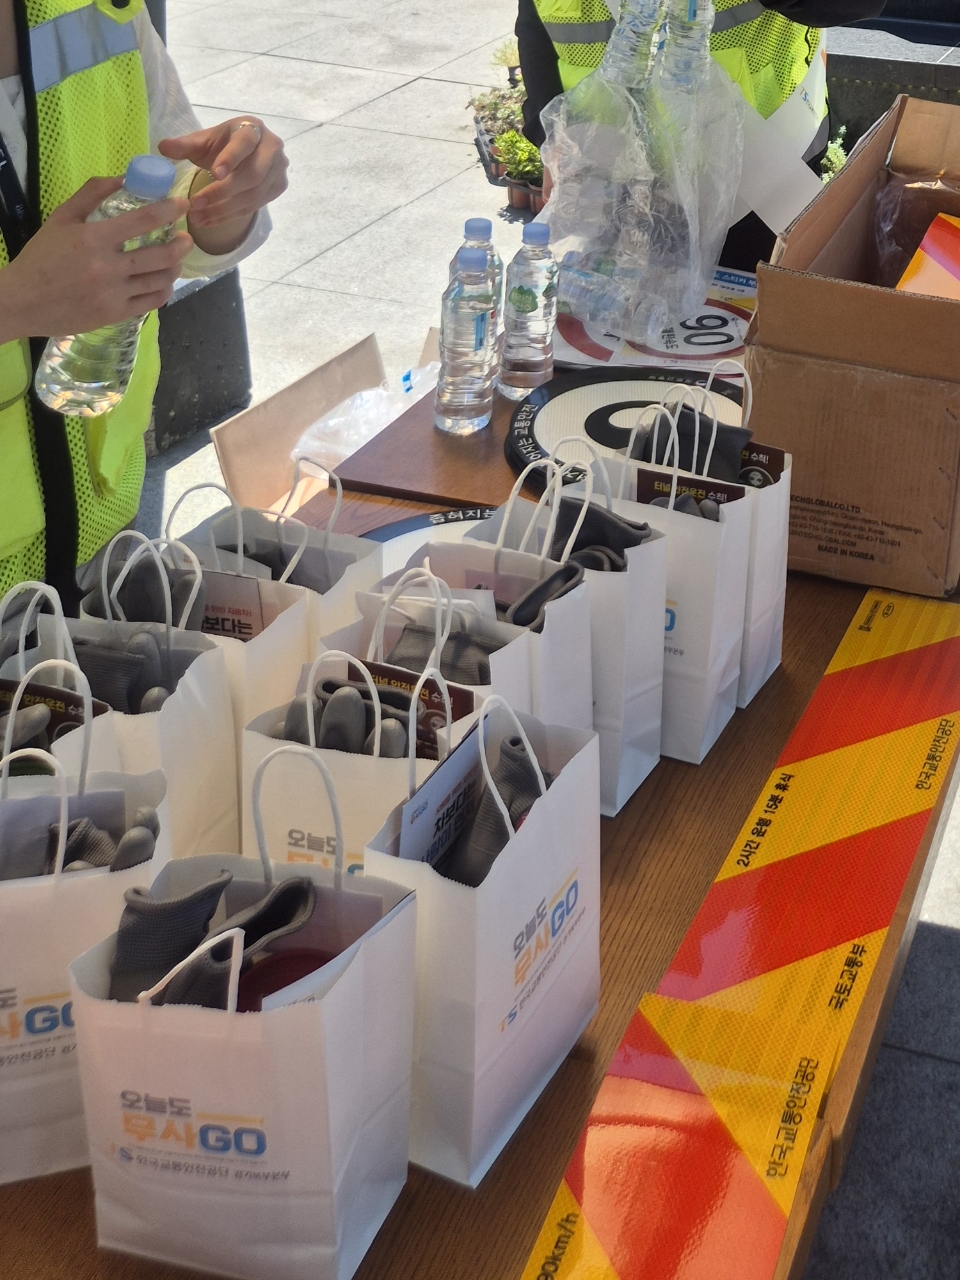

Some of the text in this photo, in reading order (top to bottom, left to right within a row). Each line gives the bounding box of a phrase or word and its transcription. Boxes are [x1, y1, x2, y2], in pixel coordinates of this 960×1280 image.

[679, 314, 735, 346] 90
[513, 404, 540, 436] 교통안전
[817, 544, 838, 555] MADE
[849, 550, 875, 561] KOREA
[201, 615, 254, 636] 보다는
[915, 717, 956, 791] 한국교통안전공단
[736, 839, 761, 867] 2시간
[763, 793, 784, 815] 15분
[774, 772, 795, 792] 휴식
[513, 897, 548, 960] 오늘도
[828, 942, 867, 1011] 국토교통부
[120, 1089, 192, 1118] 오늘도
[765, 1055, 820, 1178] 한국교통안전공단
[122, 1111, 268, 1156] 무사GO
